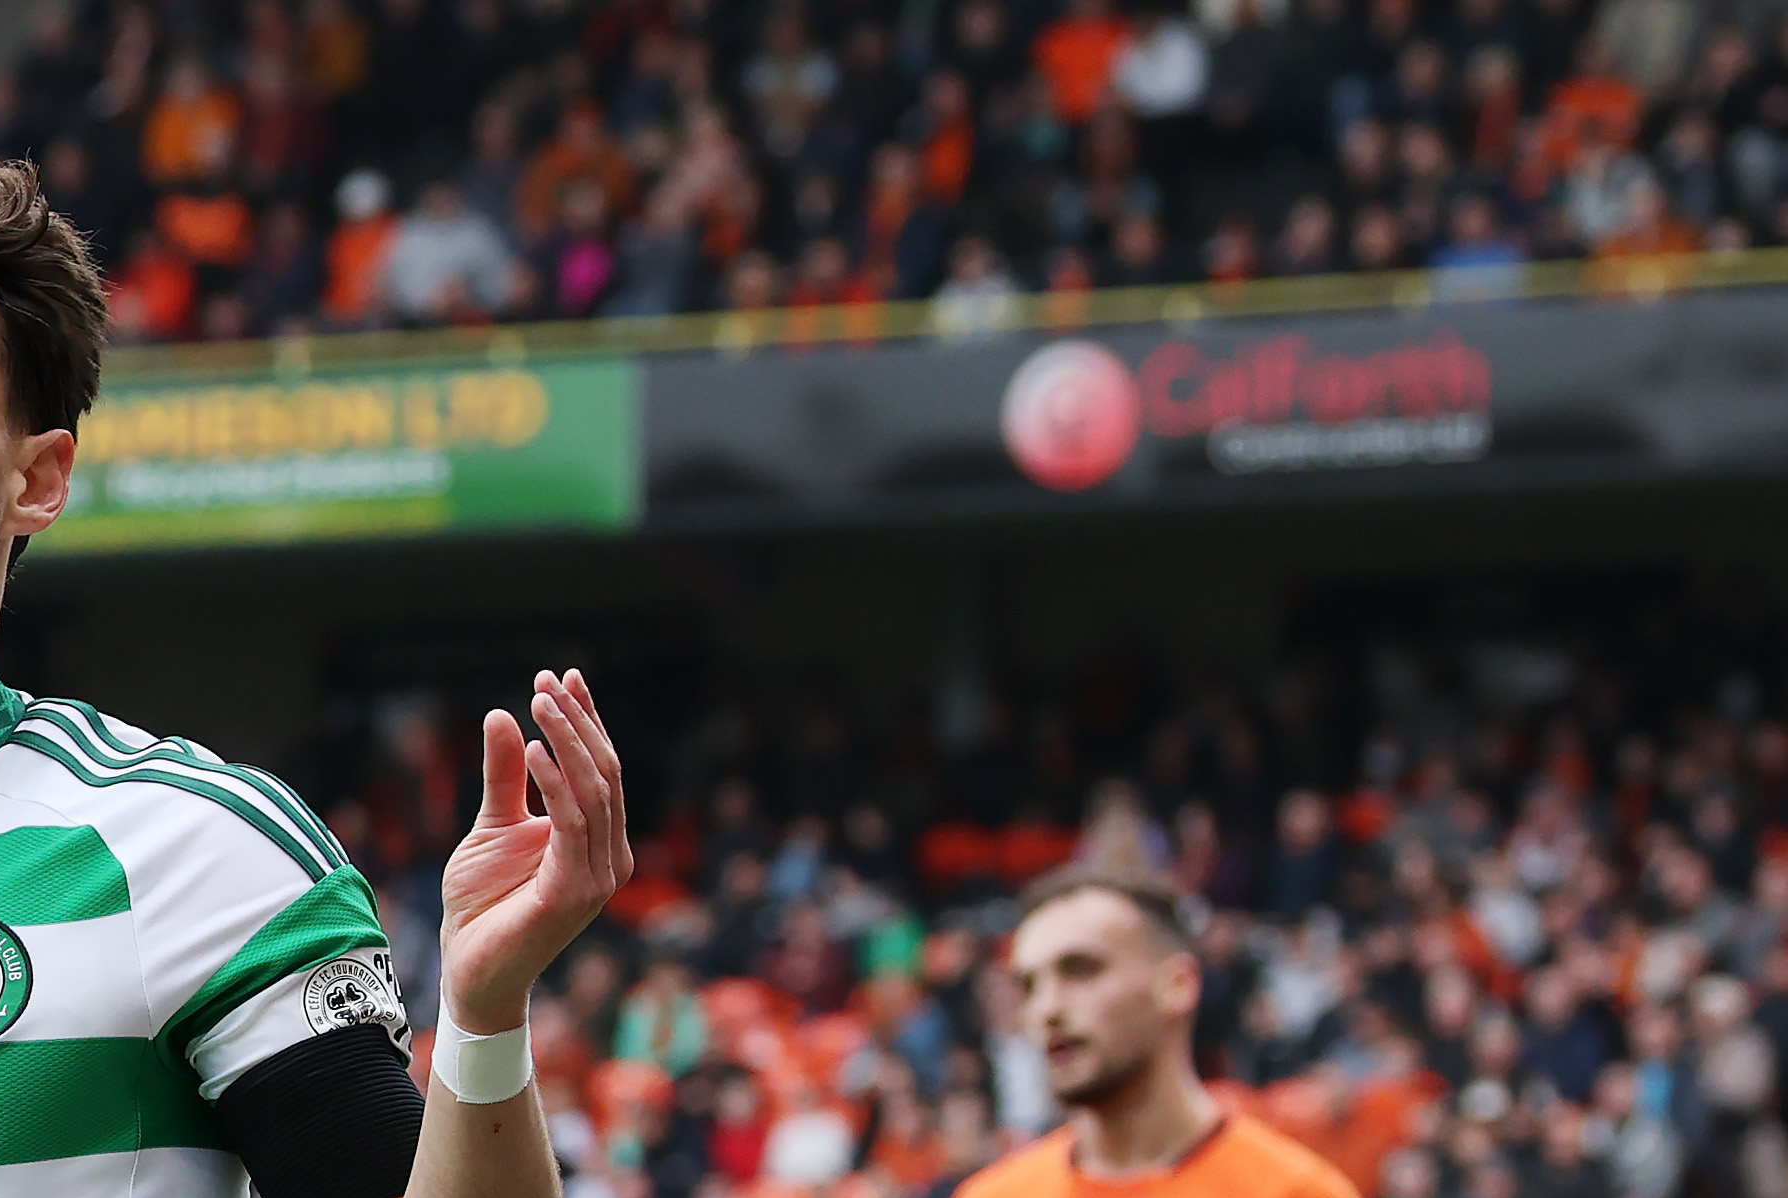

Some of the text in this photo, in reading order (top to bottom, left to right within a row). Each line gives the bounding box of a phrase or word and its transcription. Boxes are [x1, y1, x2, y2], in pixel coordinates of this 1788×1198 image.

[408, 373, 545, 450] LTD
[2, 947, 23, 982] CLUB
[309, 963, 381, 1010] CELTIC FC FOUNDATION
